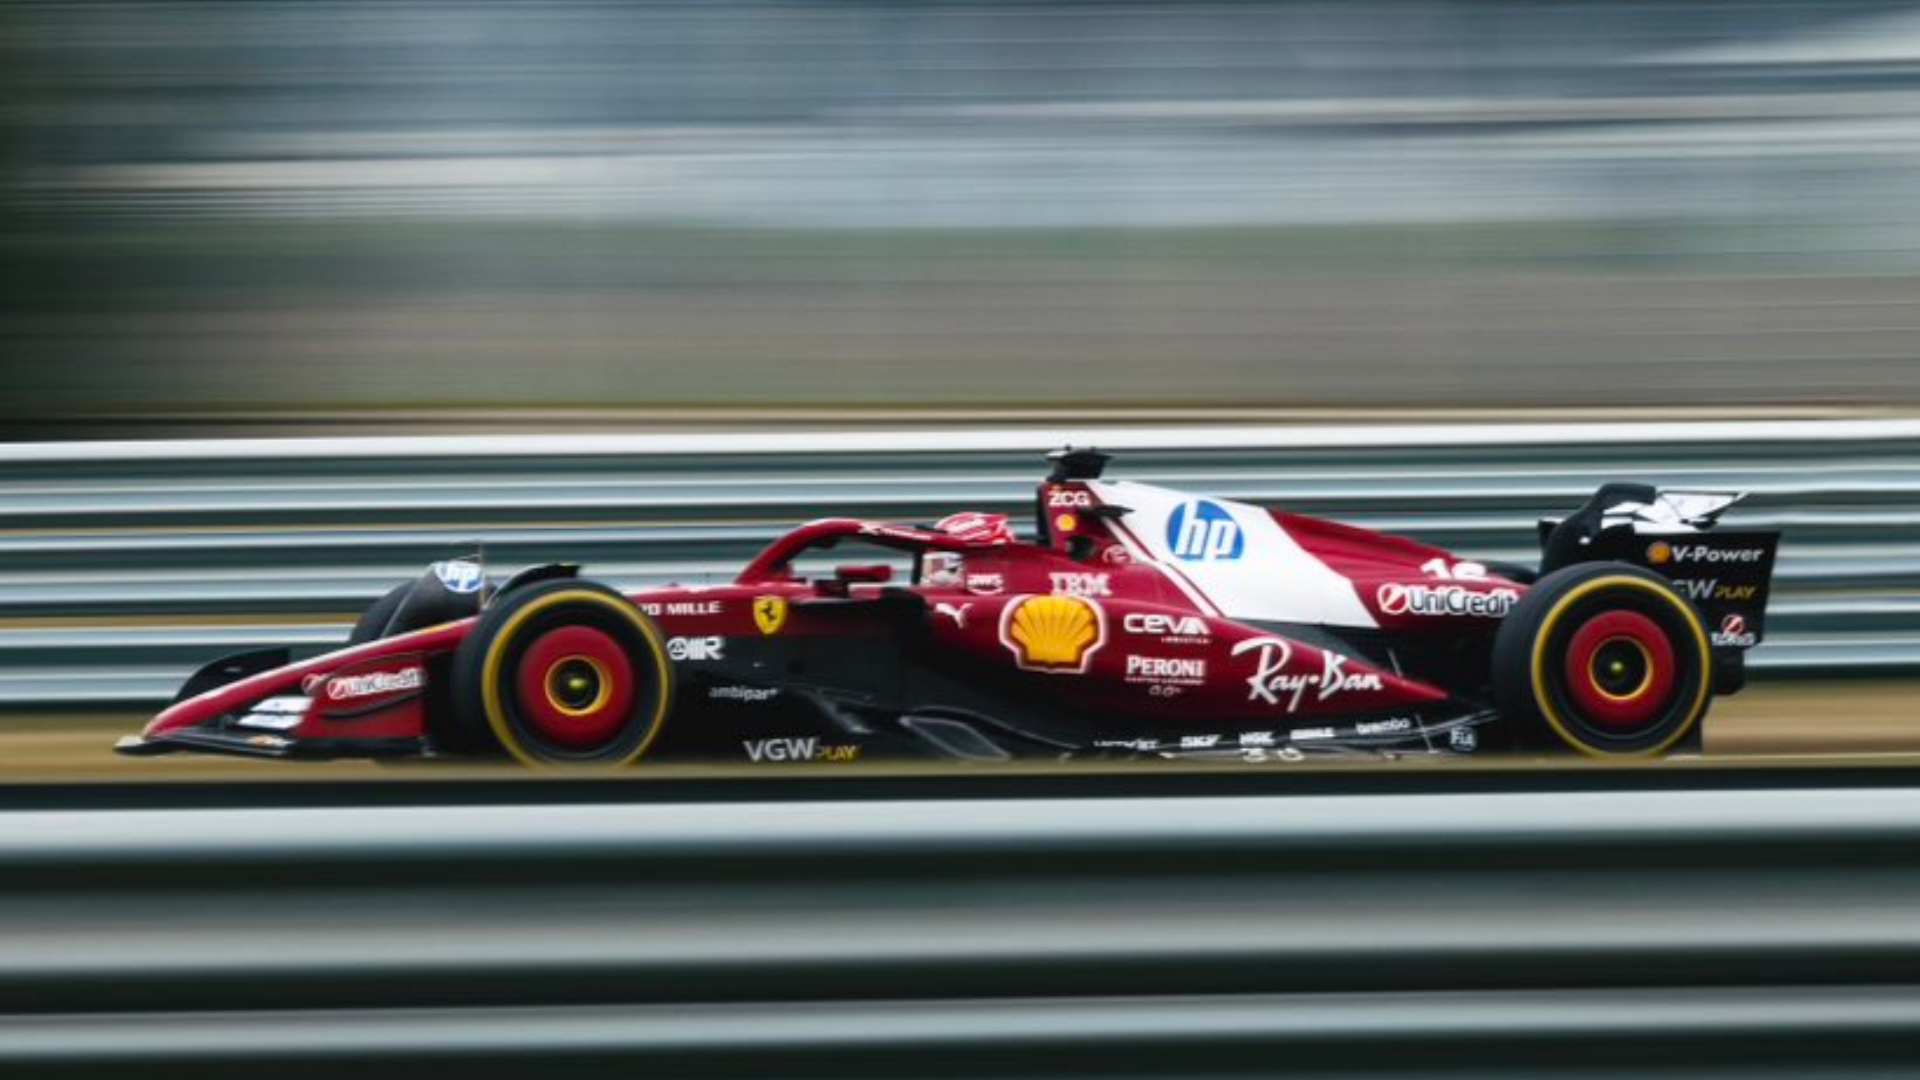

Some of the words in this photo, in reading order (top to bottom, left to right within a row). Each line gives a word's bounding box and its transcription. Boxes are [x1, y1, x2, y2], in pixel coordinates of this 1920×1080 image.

[1174, 501, 1239, 559] hp
[1671, 545, 1764, 563] V-Power
[1049, 572, 1113, 597] IBM
[666, 601, 723, 616] MILLE
[1126, 654, 1207, 677] PERONI
[743, 738, 821, 762] VGW
